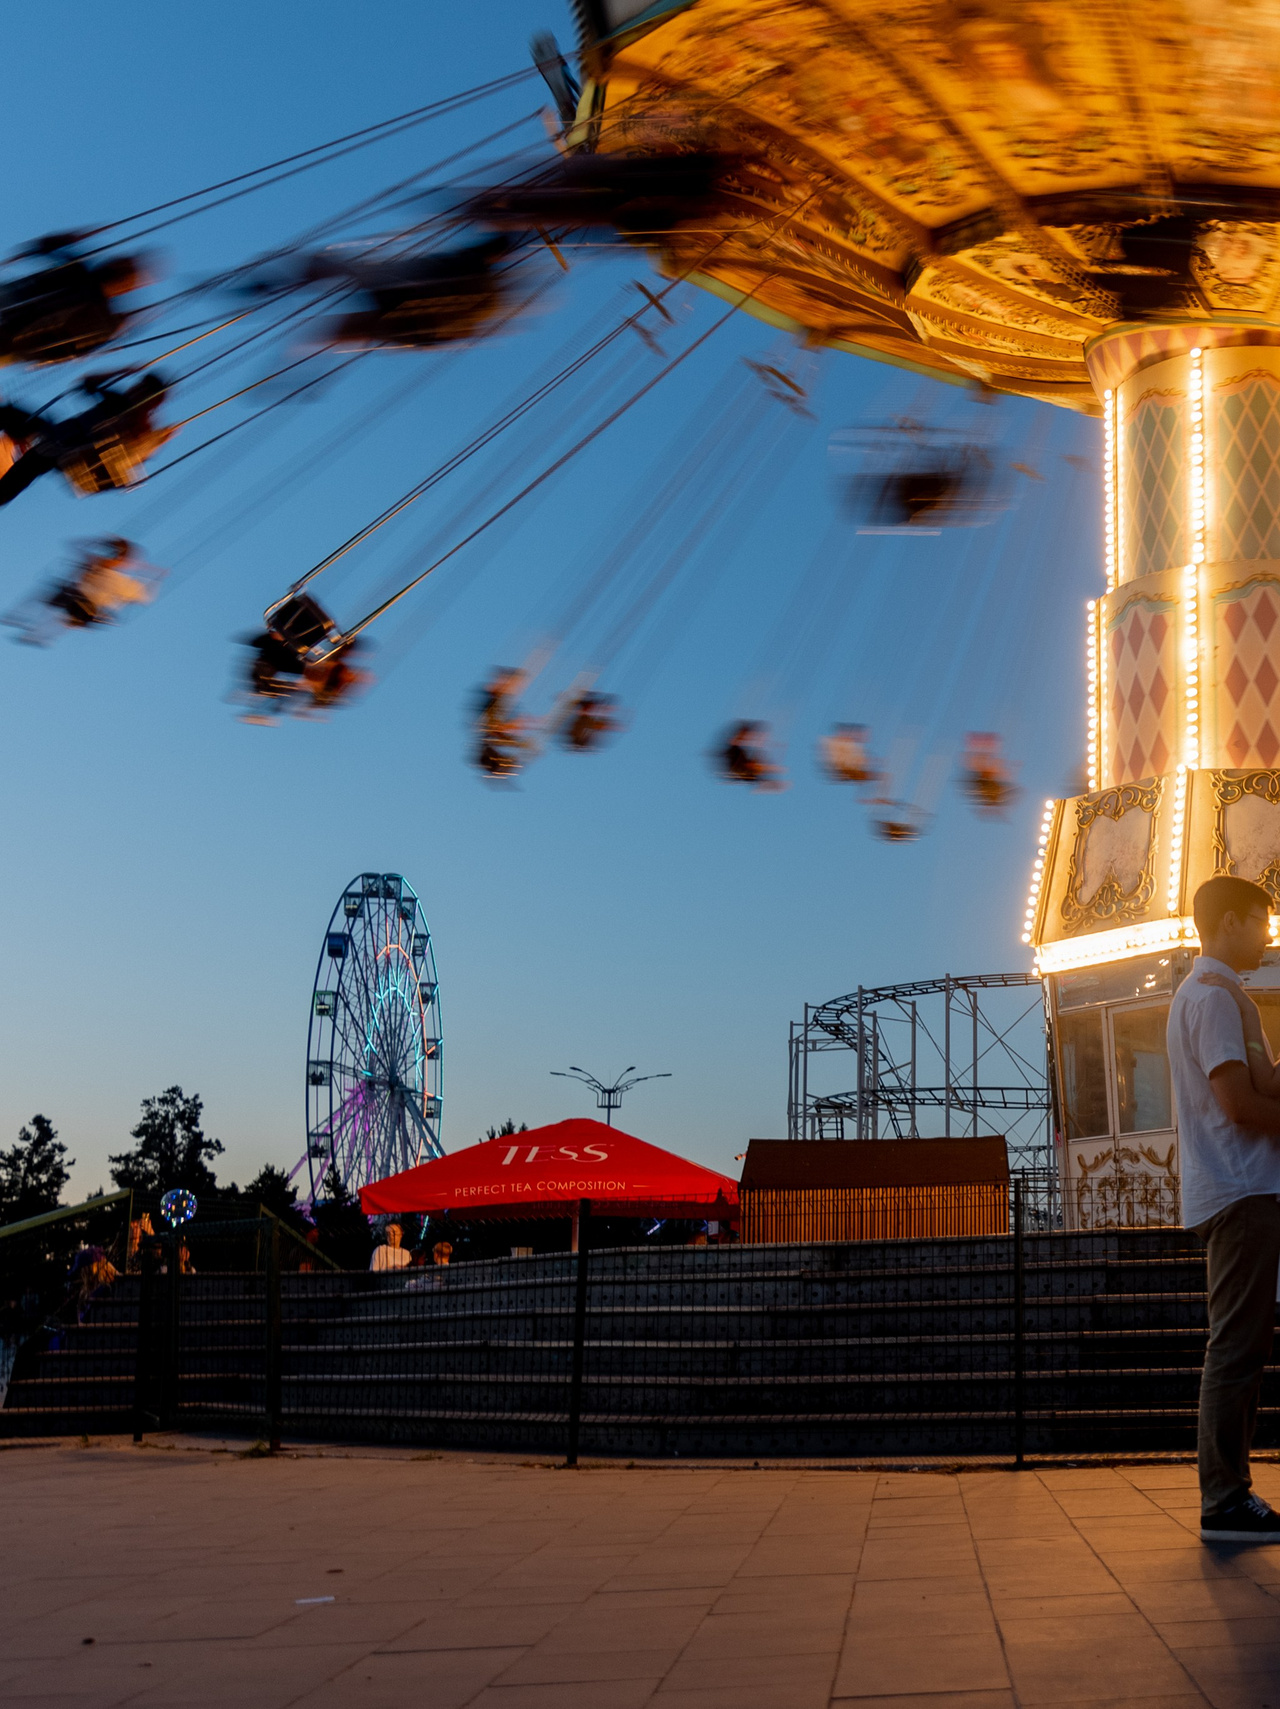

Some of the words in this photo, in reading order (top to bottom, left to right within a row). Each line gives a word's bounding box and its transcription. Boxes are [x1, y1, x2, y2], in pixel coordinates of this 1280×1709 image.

[498, 1143, 609, 1165] TESS
[454, 1184, 507, 1197] PERFECT
[511, 1182, 532, 1192] TEA
[536, 1181, 626, 1191] COMPOSITION
